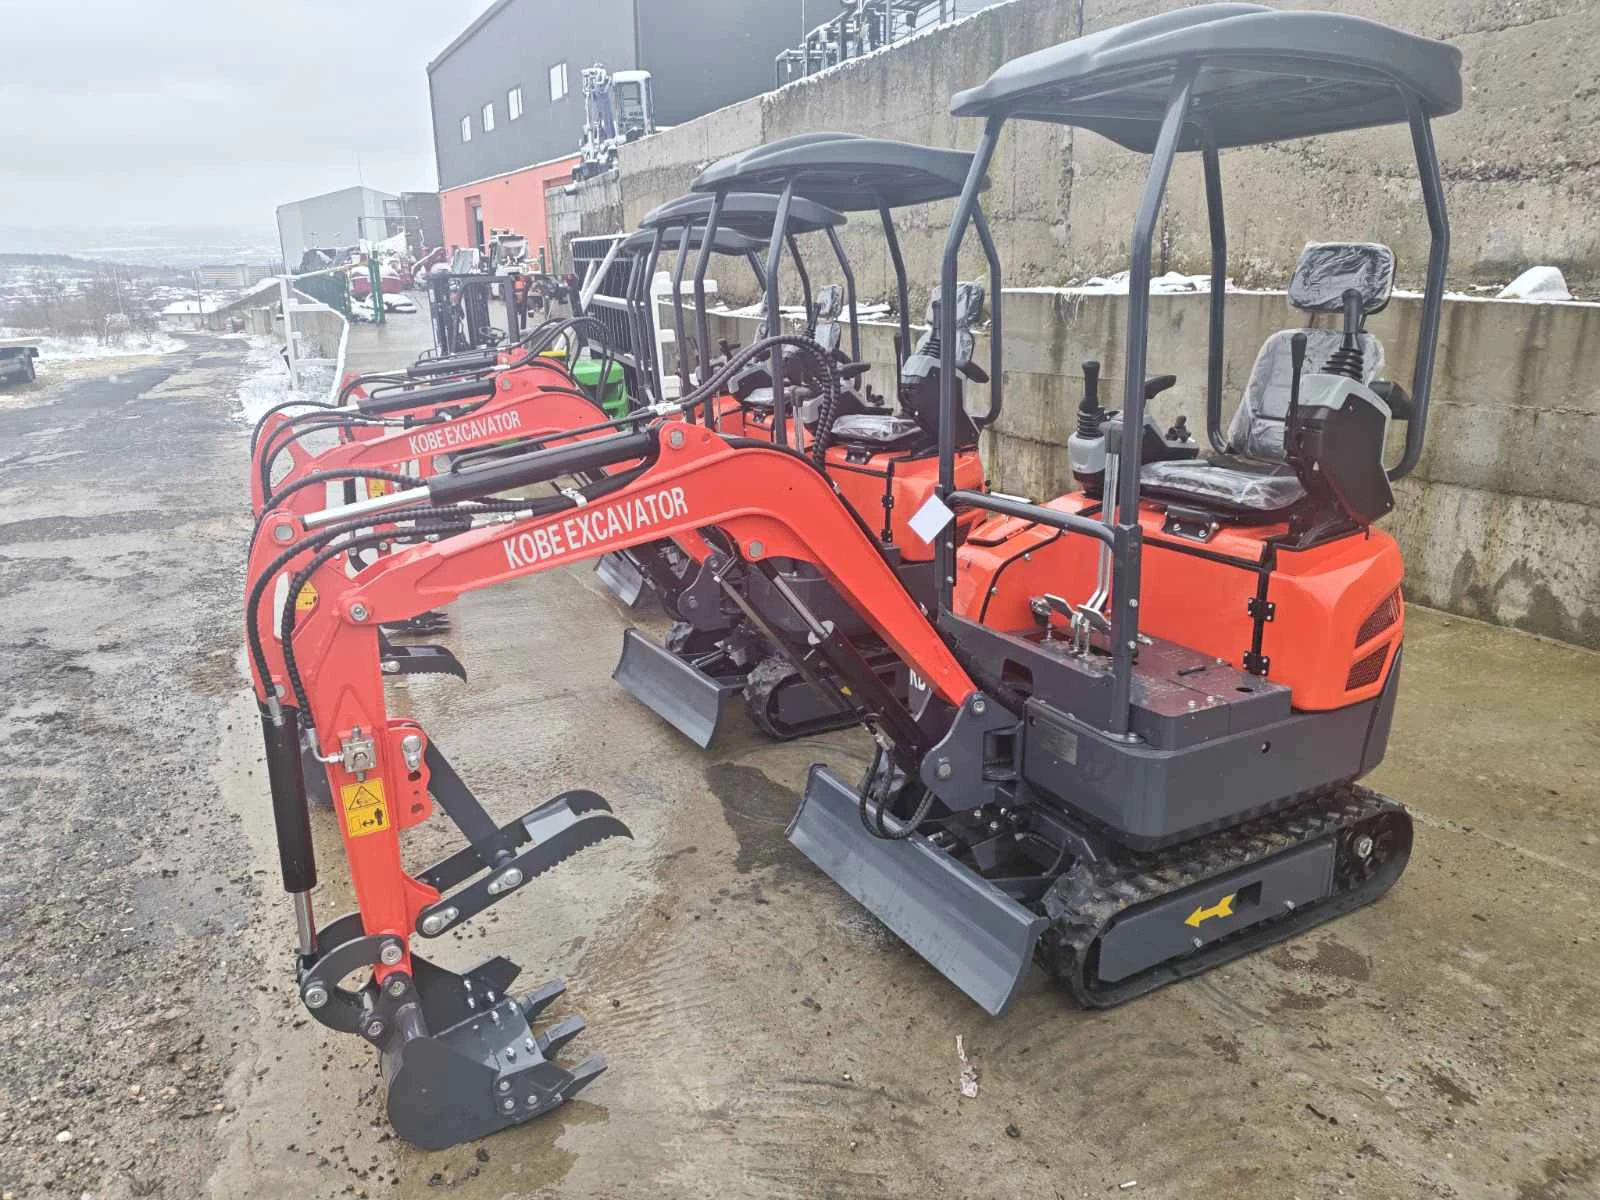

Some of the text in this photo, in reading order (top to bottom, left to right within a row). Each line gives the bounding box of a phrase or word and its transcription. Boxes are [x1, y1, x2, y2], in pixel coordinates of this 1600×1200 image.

[408, 410, 522, 455] KOBE EXCAVATOR
[502, 486, 689, 570] KOBE EXCAVATOR
